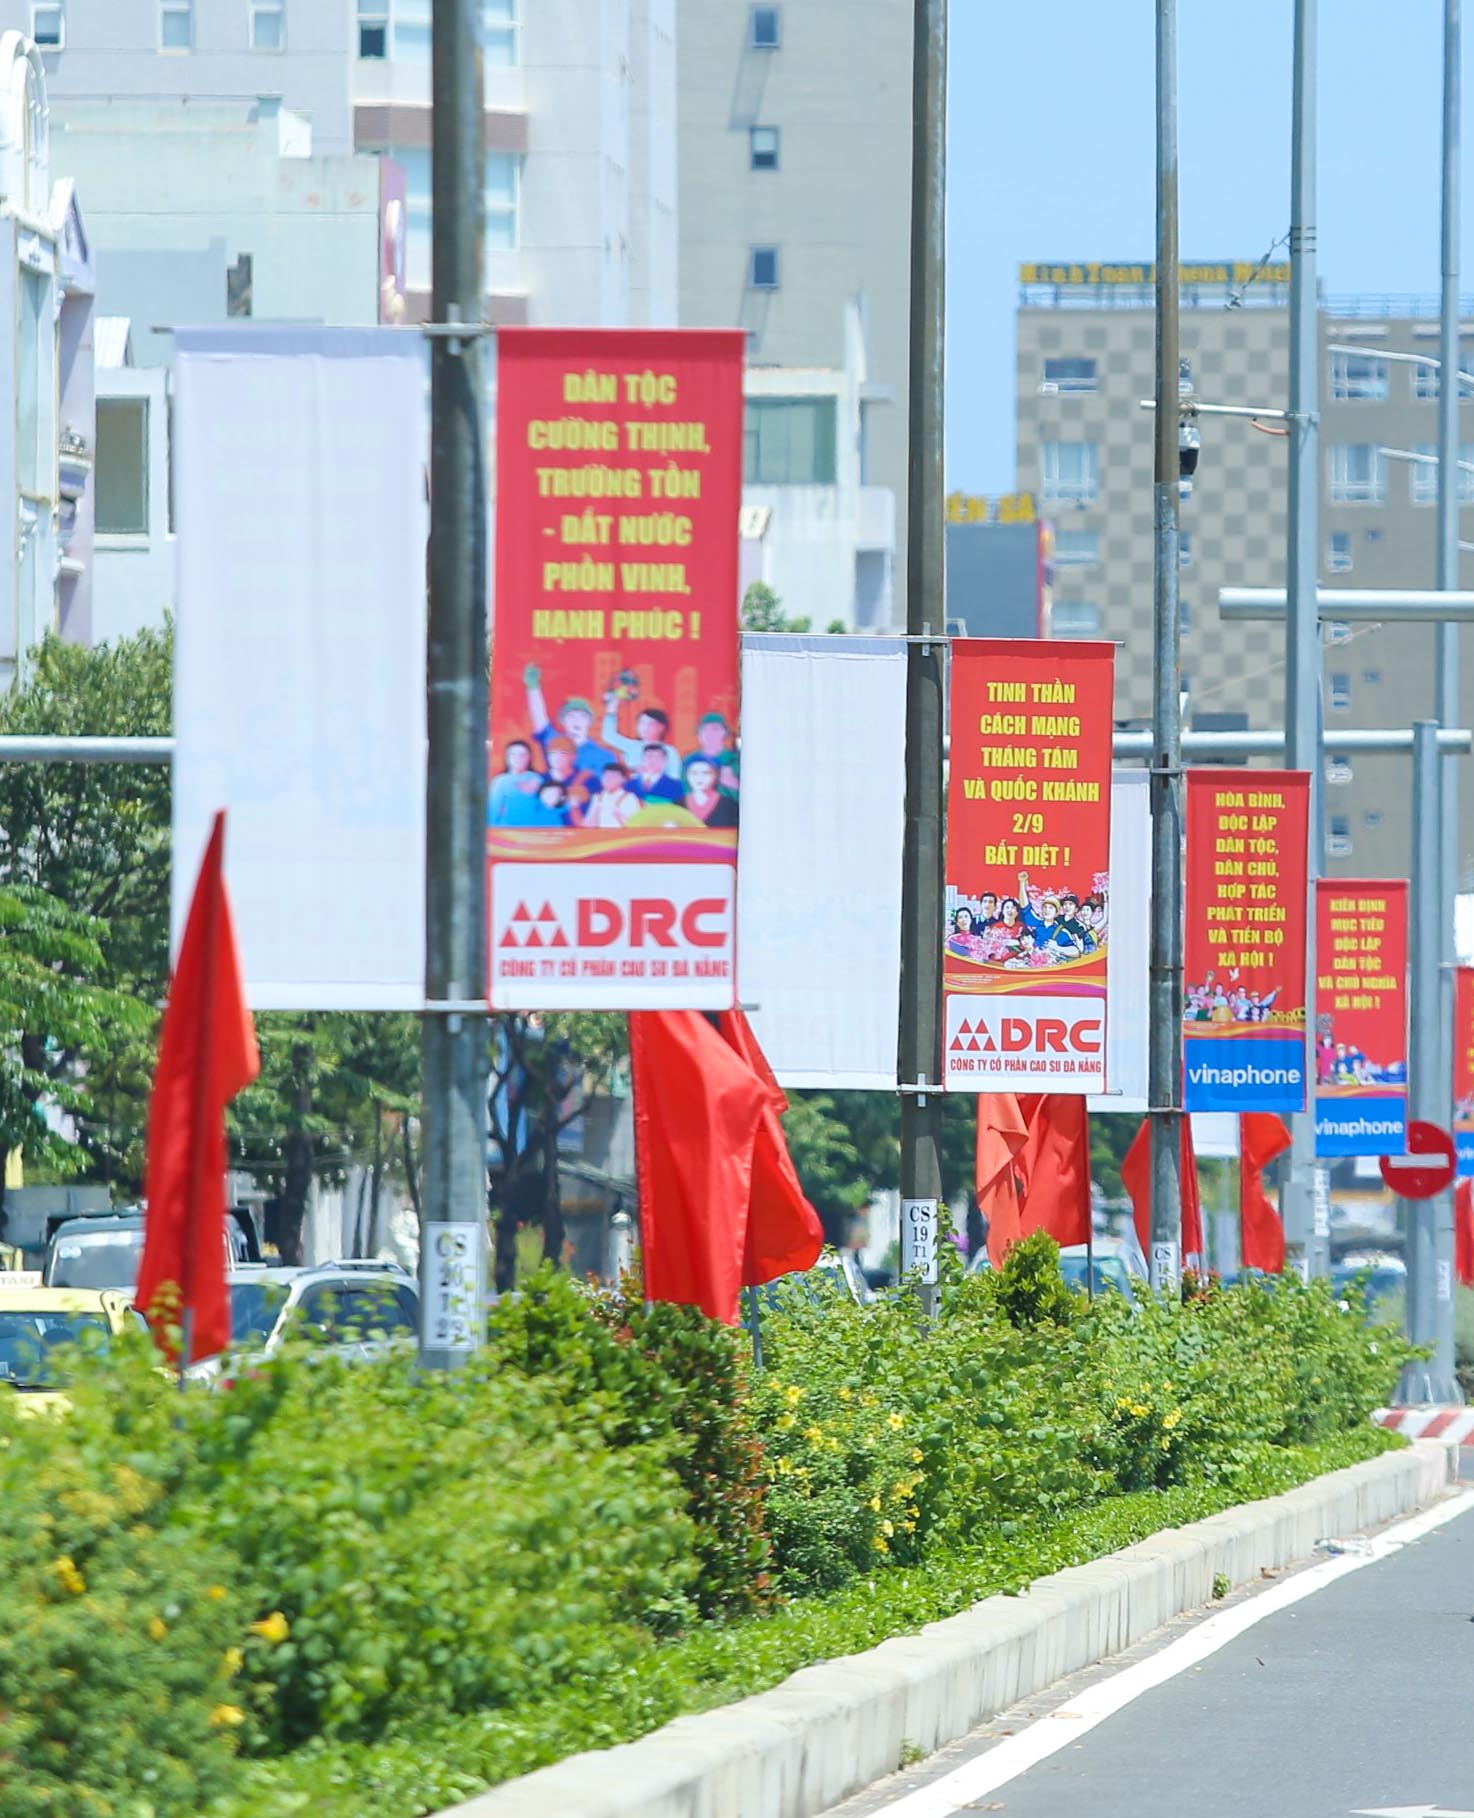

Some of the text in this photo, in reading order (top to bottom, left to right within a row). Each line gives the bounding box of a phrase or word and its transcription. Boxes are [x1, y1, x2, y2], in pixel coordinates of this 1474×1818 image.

[563, 369, 677, 410] DÂN TỘC
[528, 416, 711, 456] CƯỜNG THỊNH,
[536, 460, 701, 498] TRƯỜNG TỒN
[561, 506, 614, 545] ĐẤT
[619, 511, 693, 545] NƯỚC
[544, 552, 691, 595] PHỒN VINH,
[532, 609, 604, 645] HẠNH
[611, 606, 684, 640] PHÚC
[987, 677, 1076, 704] TINH THẦN
[980, 712, 1081, 740] CÁCH MẠNG
[981, 744, 1078, 769] THÁNG TÁM
[963, 773, 1100, 802] VÀ QUỐC KHÁNH
[1215, 792, 1245, 808] HÒA
[1012, 813, 1044, 834] 2/9
[1218, 814, 1277, 833] ĐỘC LẬP
[985, 839, 1018, 866] BẤT
[1022, 843, 1059, 869] DIỆT
[1215, 837, 1244, 853] DÂN
[1215, 859, 1243, 876] DÂN
[1217, 882, 1276, 900] HỢP TÁC
[576, 898, 728, 947] DRC
[1207, 905, 1243, 921] PHÁT
[1208, 927, 1228, 944] VÀ
[1264, 927, 1284, 946] BỘ
[1240, 951, 1264, 968] HỘI
[1001, 1017, 1102, 1053] DRC
[950, 1057, 975, 1071] CÔNG
[977, 1060, 986, 1071] TY
[1030, 1060, 1046, 1072] CAO
[1050, 1061, 1061, 1073] SU
[1188, 1063, 1301, 1088] vinaphone
[1315, 1117, 1404, 1138] vinaphone
[910, 1206, 931, 1222] CS
[913, 1226, 928, 1242] 19
[912, 1245, 926, 1257] T1
[1155, 1247, 1171, 1260] CS
